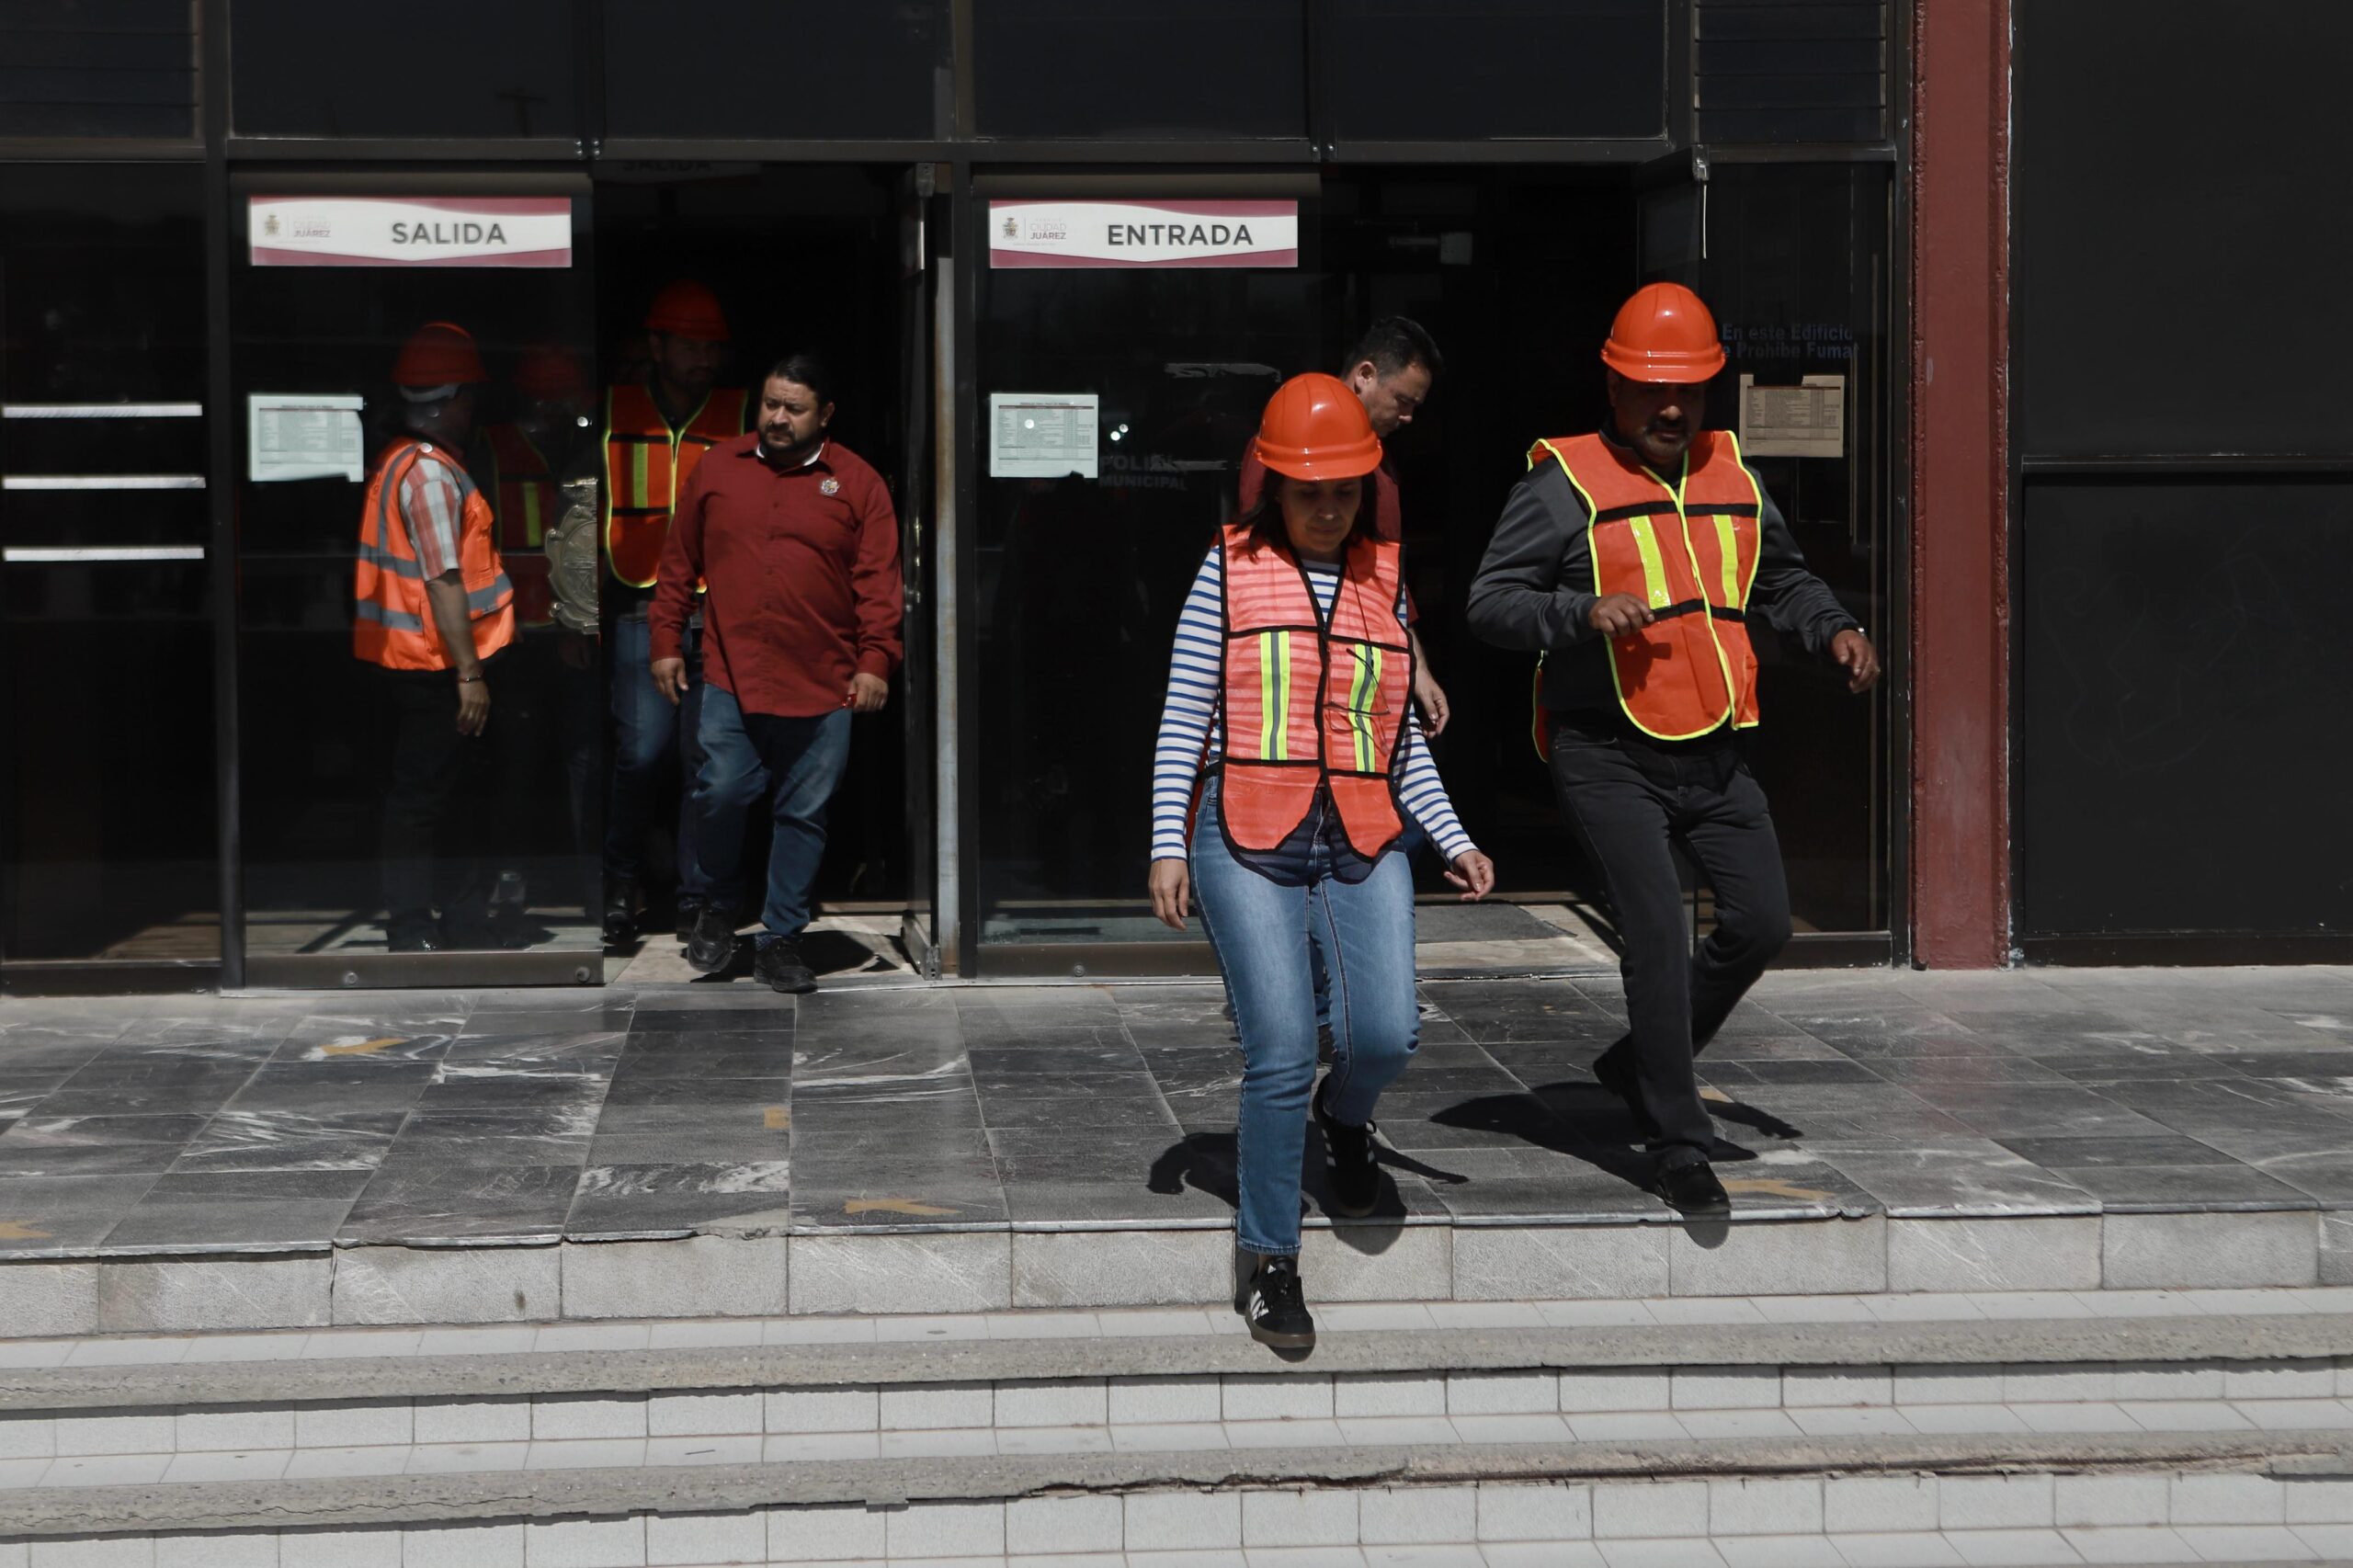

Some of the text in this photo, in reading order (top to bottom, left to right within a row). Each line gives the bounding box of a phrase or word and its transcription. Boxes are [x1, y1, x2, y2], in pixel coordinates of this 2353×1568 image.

[392, 222, 506, 244] SALIDA
[1108, 224, 1254, 245] ENTRADA
[1722, 324, 1852, 340] En este Edificio
[1736, 342, 1800, 358] Prohibe
[1807, 342, 1854, 358] Fuma
[1099, 474, 1188, 490] MUNICIPAL
